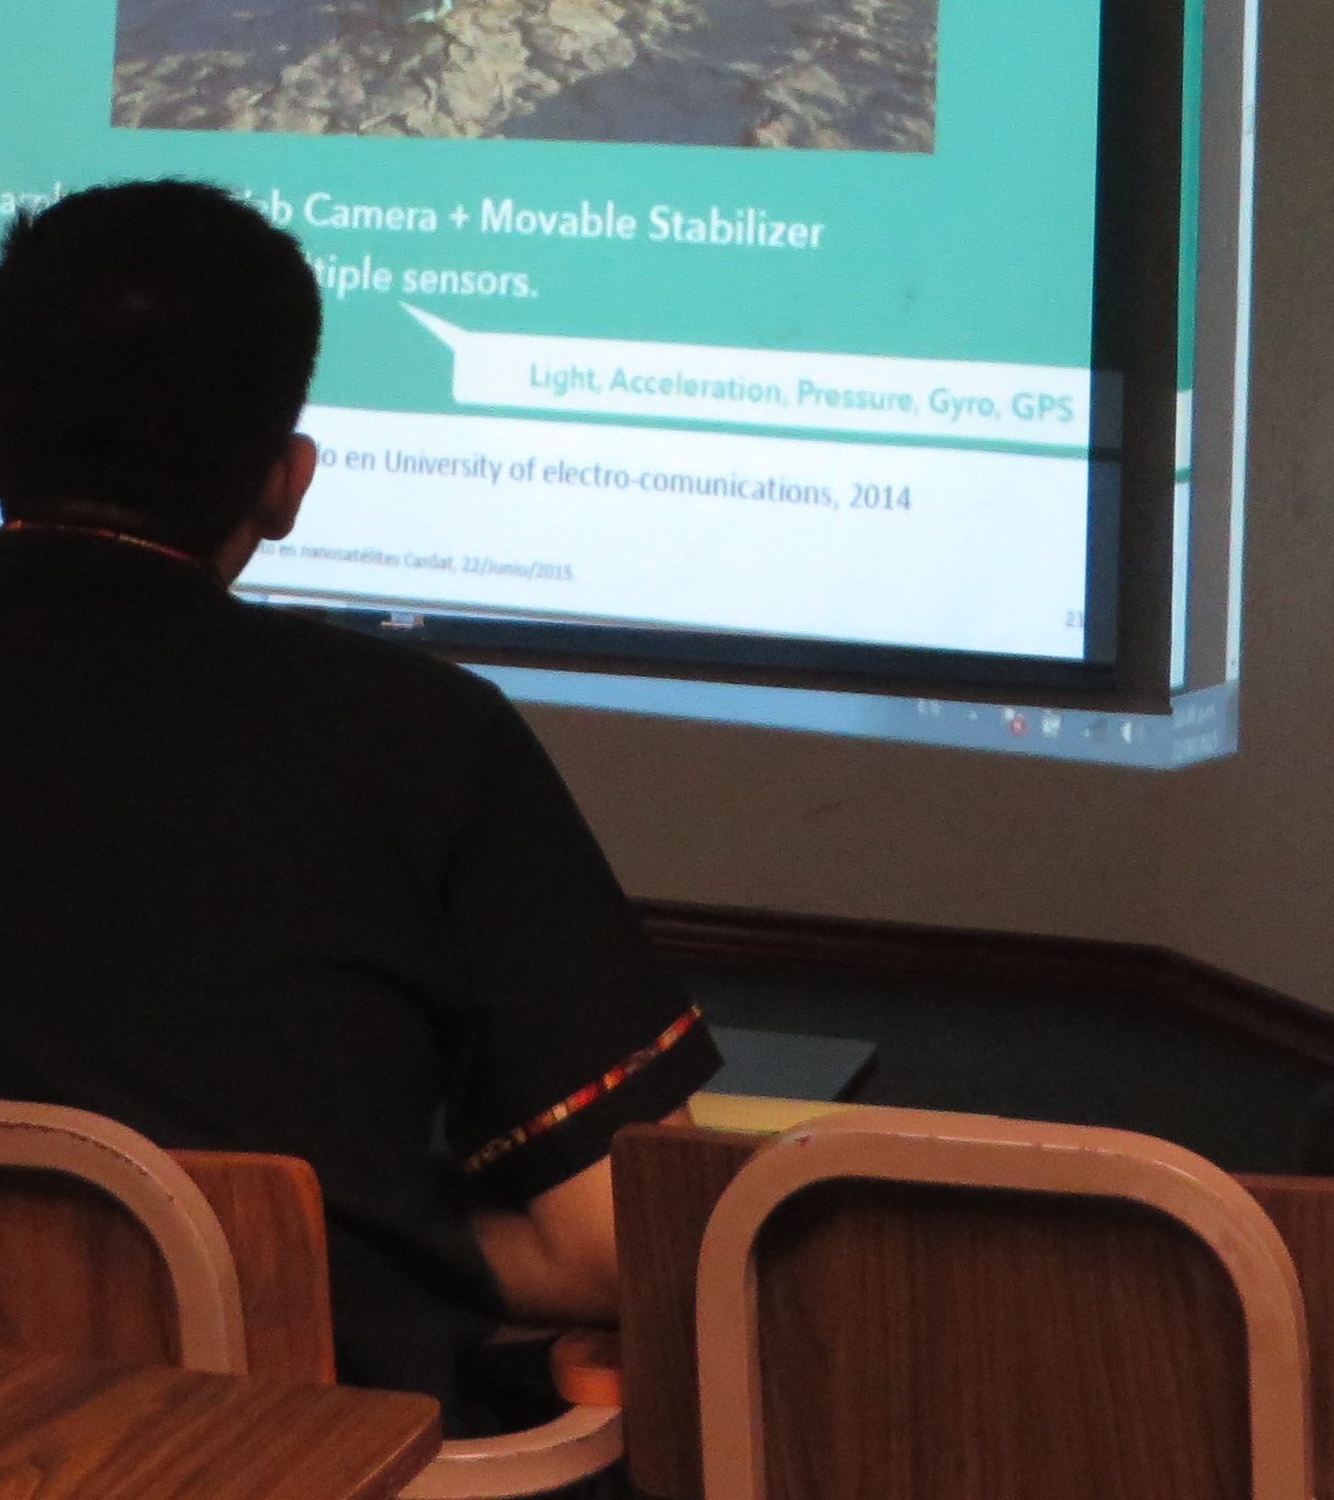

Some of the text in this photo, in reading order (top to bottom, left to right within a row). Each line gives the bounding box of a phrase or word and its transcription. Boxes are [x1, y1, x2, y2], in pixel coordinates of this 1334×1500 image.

[304, 192, 437, 233] Camera
[480, 196, 637, 240] Movable
[648, 203, 825, 250] Stabilizer
[312, 255, 540, 299] tiple sensors.
[530, 363, 1075, 424] Light, Acceleration, Pressure, Gyro, GPS
[344, 452, 376, 472] en
[384, 447, 503, 485] University
[509, 455, 537, 482] of
[542, 457, 840, 512] electro-comunications,
[849, 483, 912, 511] 2014
